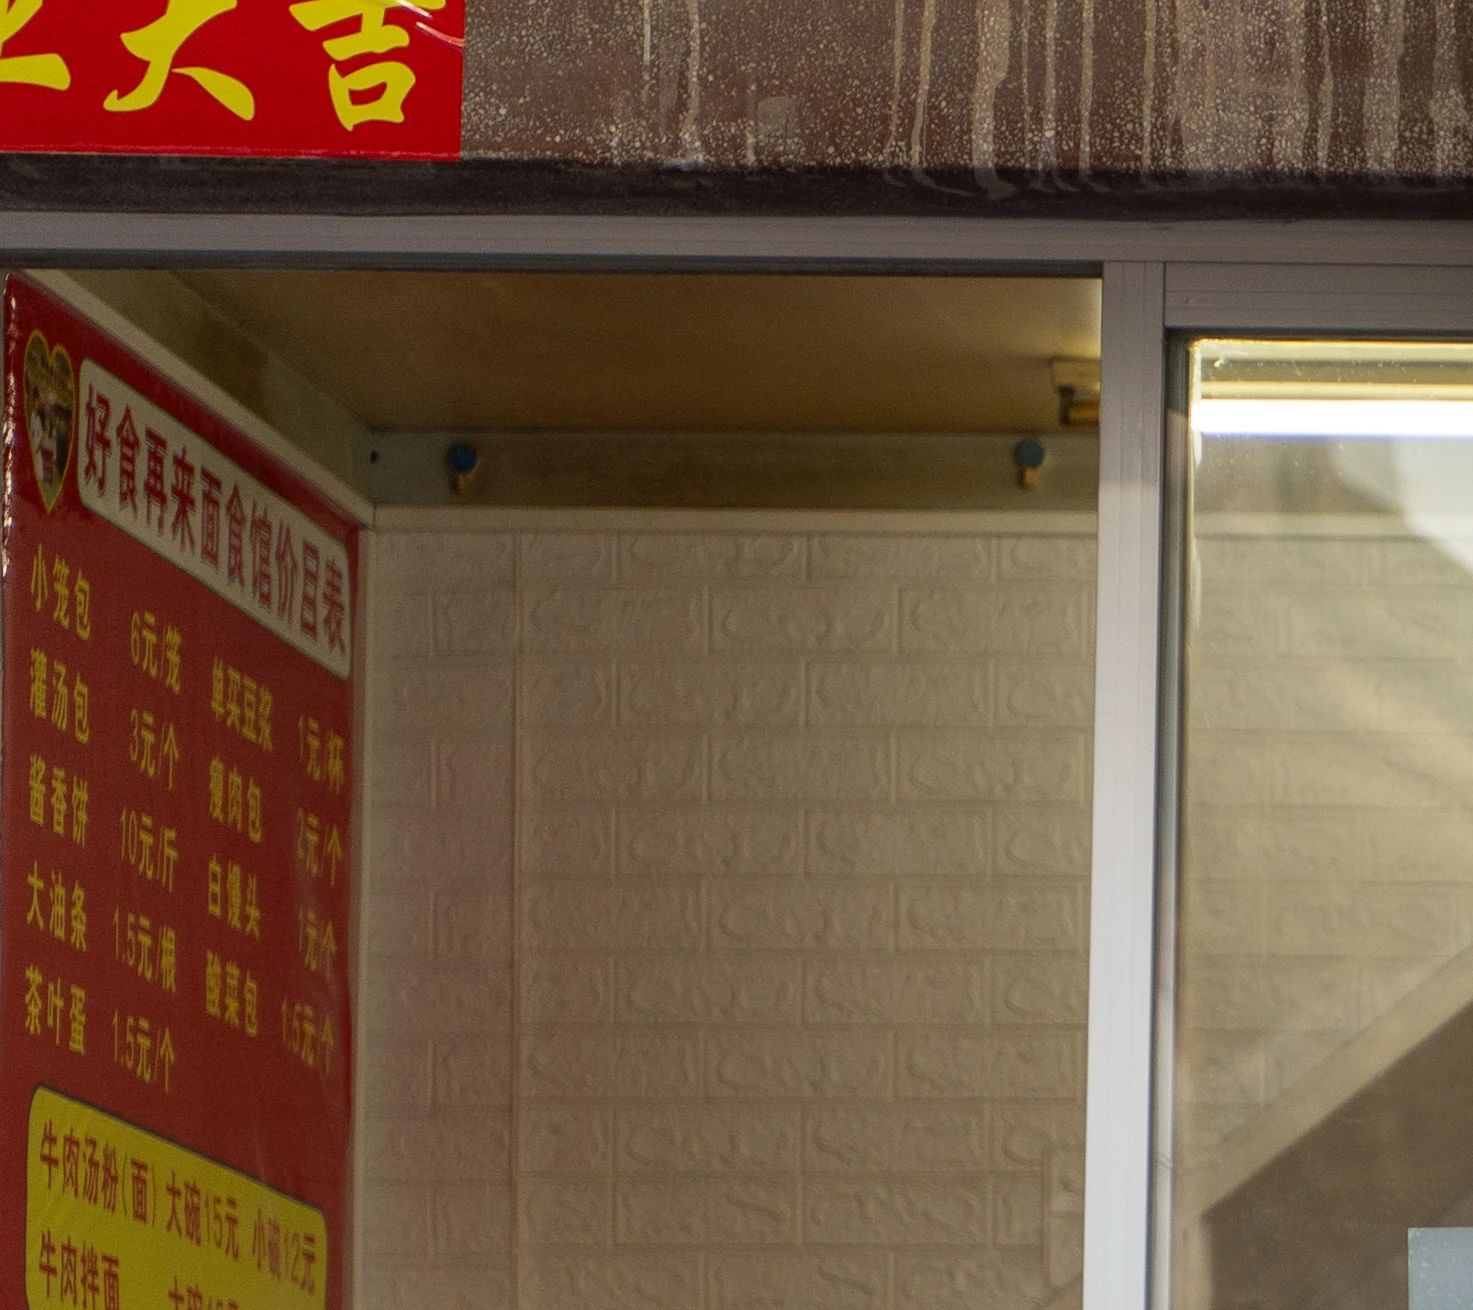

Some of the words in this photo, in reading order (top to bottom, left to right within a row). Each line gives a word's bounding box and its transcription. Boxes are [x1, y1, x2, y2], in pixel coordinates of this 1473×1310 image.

[85, 382, 348, 655] 好食再来面食馆价目表
[31, 543, 91, 641] 小笼包
[131, 610, 182, 695] 6元/笼
[30, 647, 89, 745] 灌汤包
[129, 707, 180, 791] 3元/个
[30, 752, 89, 848] 酱香饼
[120, 806, 178, 893] 10元/斤
[26, 859, 87, 952] 大油条
[113, 904, 176, 993] 1.5元/根
[208, 853, 261, 941] 白馒头
[25, 963, 86, 1056] 茶叶蛋
[112, 1007, 176, 1095] 1.5元/个
[206, 949, 259, 1038] 酸菜包
[166, 1168, 240, 1263] 大碗15元
[252, 1207, 316, 1296] 小碗12元
